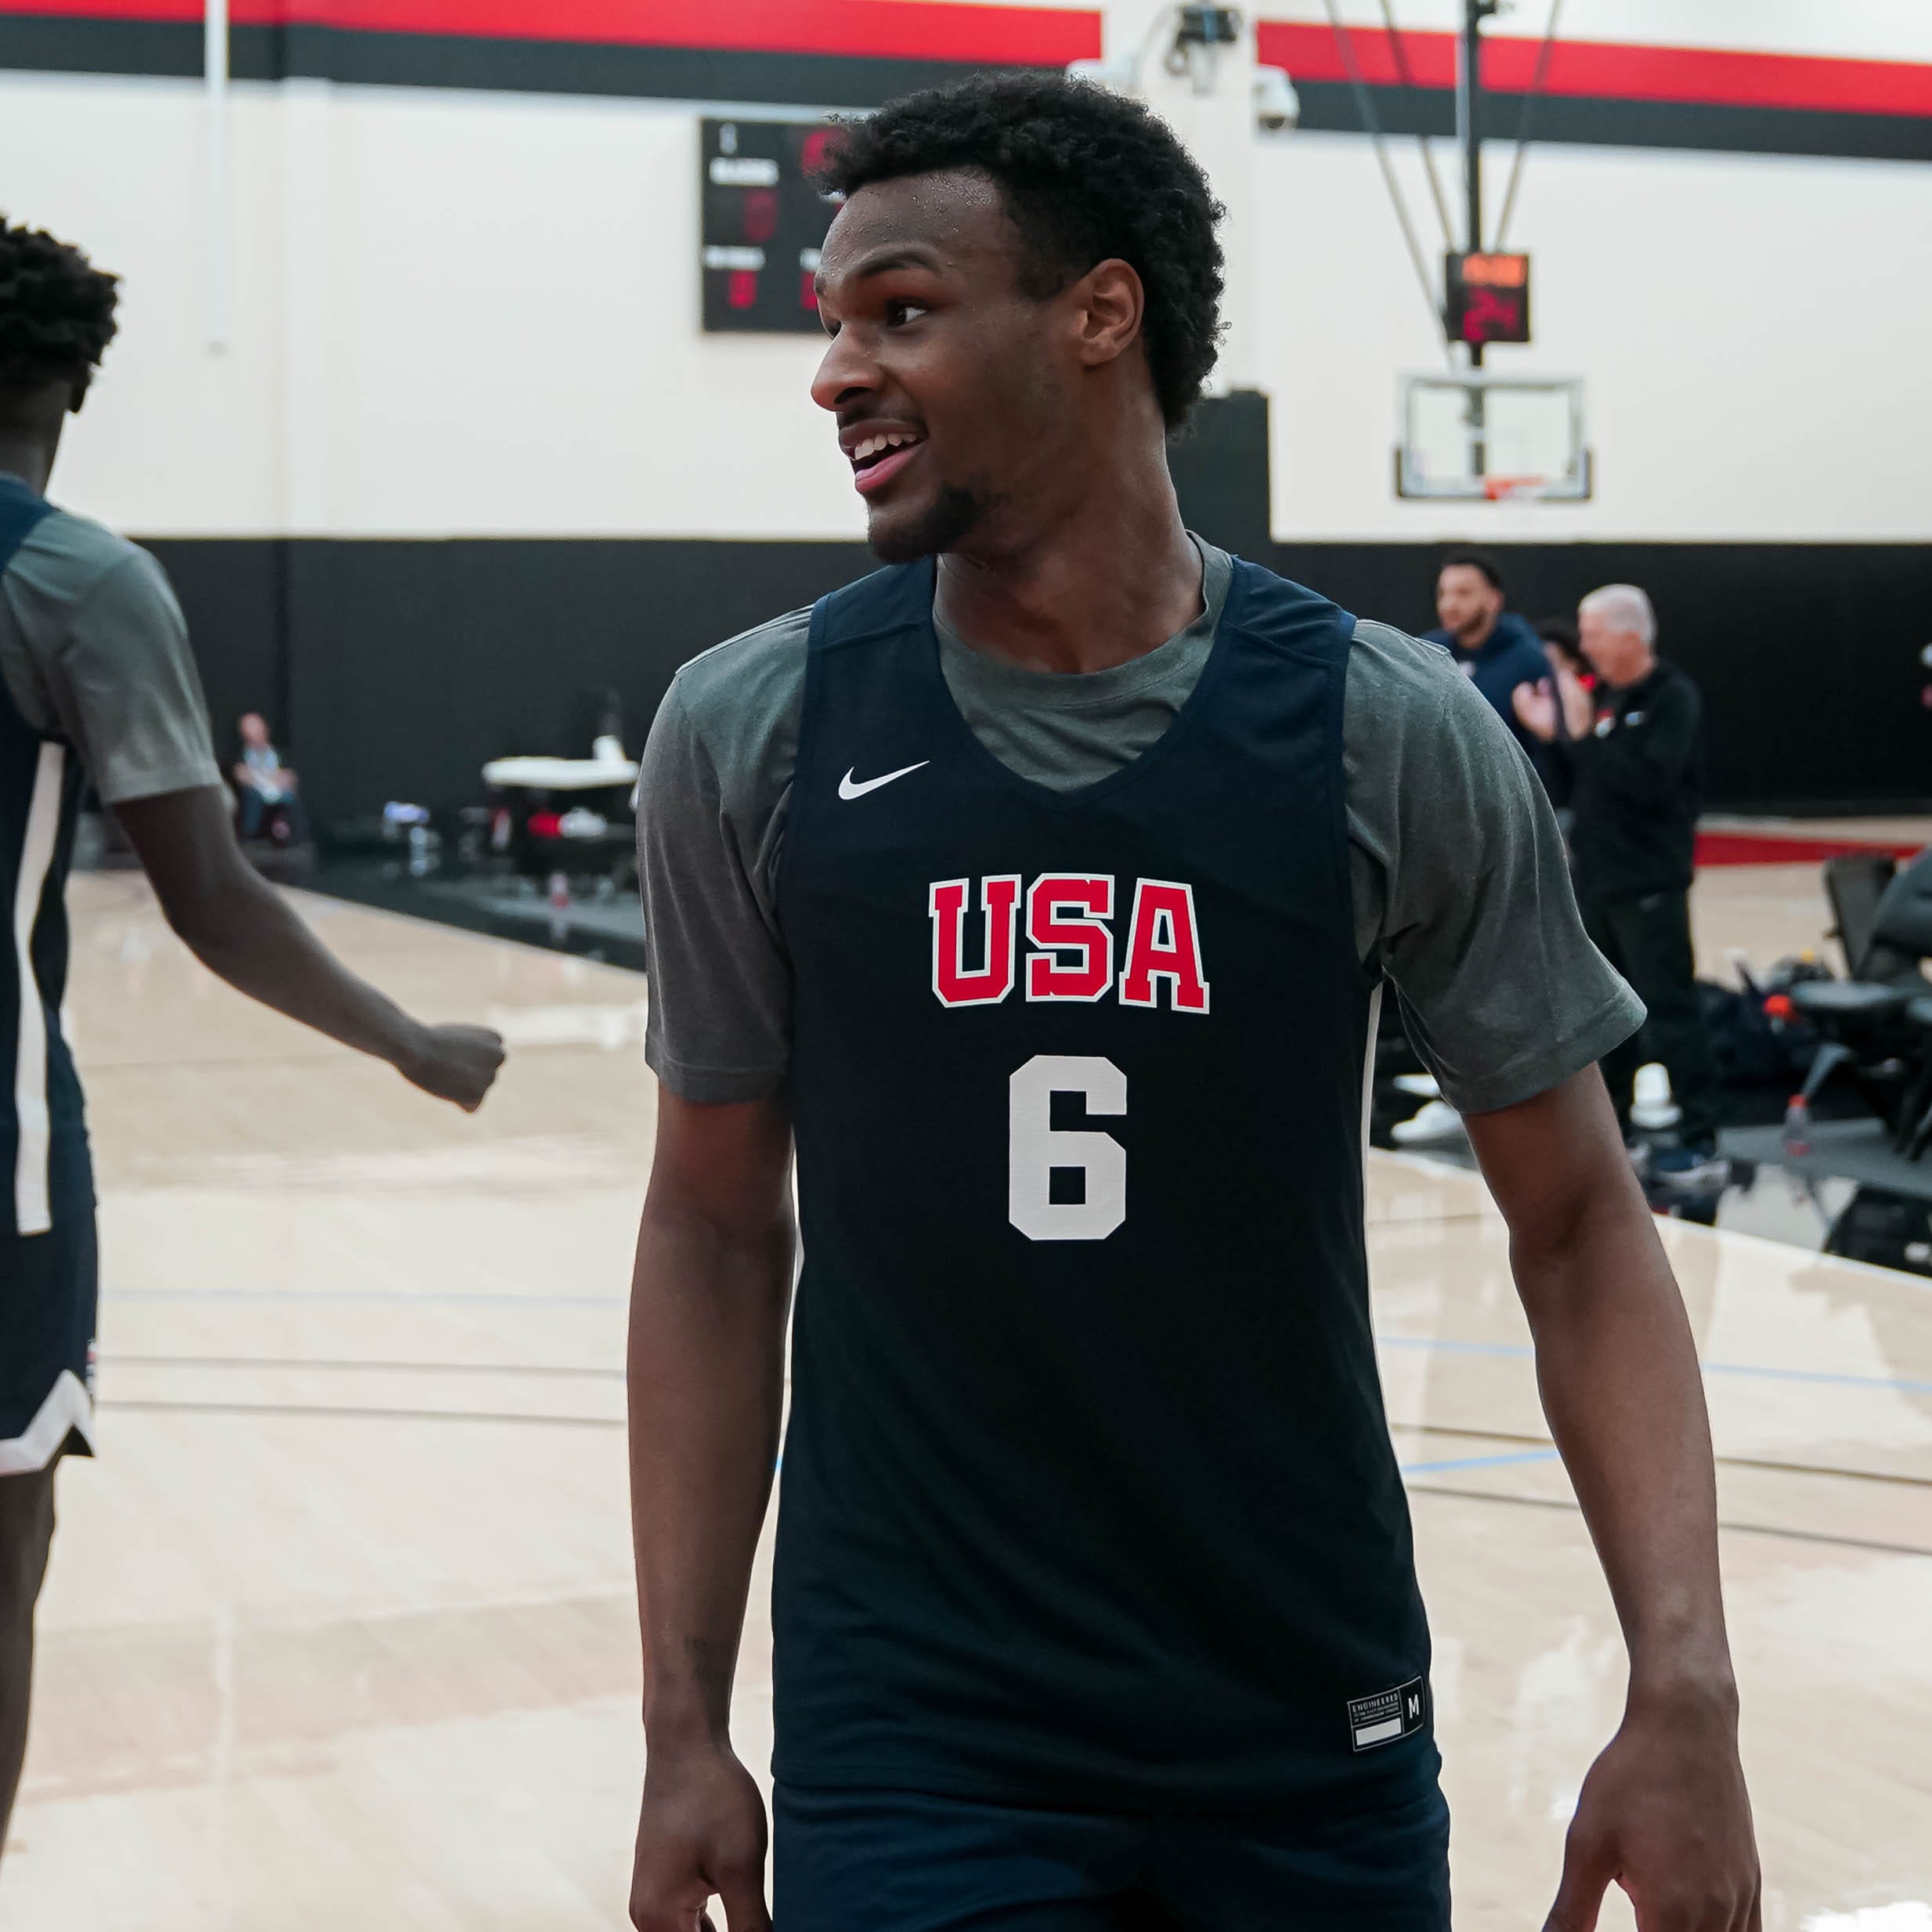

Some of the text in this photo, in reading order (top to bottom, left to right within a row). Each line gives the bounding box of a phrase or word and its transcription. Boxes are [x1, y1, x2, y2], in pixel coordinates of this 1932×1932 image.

[929, 872, 1210, 1015] USA
[1009, 1055, 1127, 1240] 6
[1408, 1693, 1420, 1719] M
